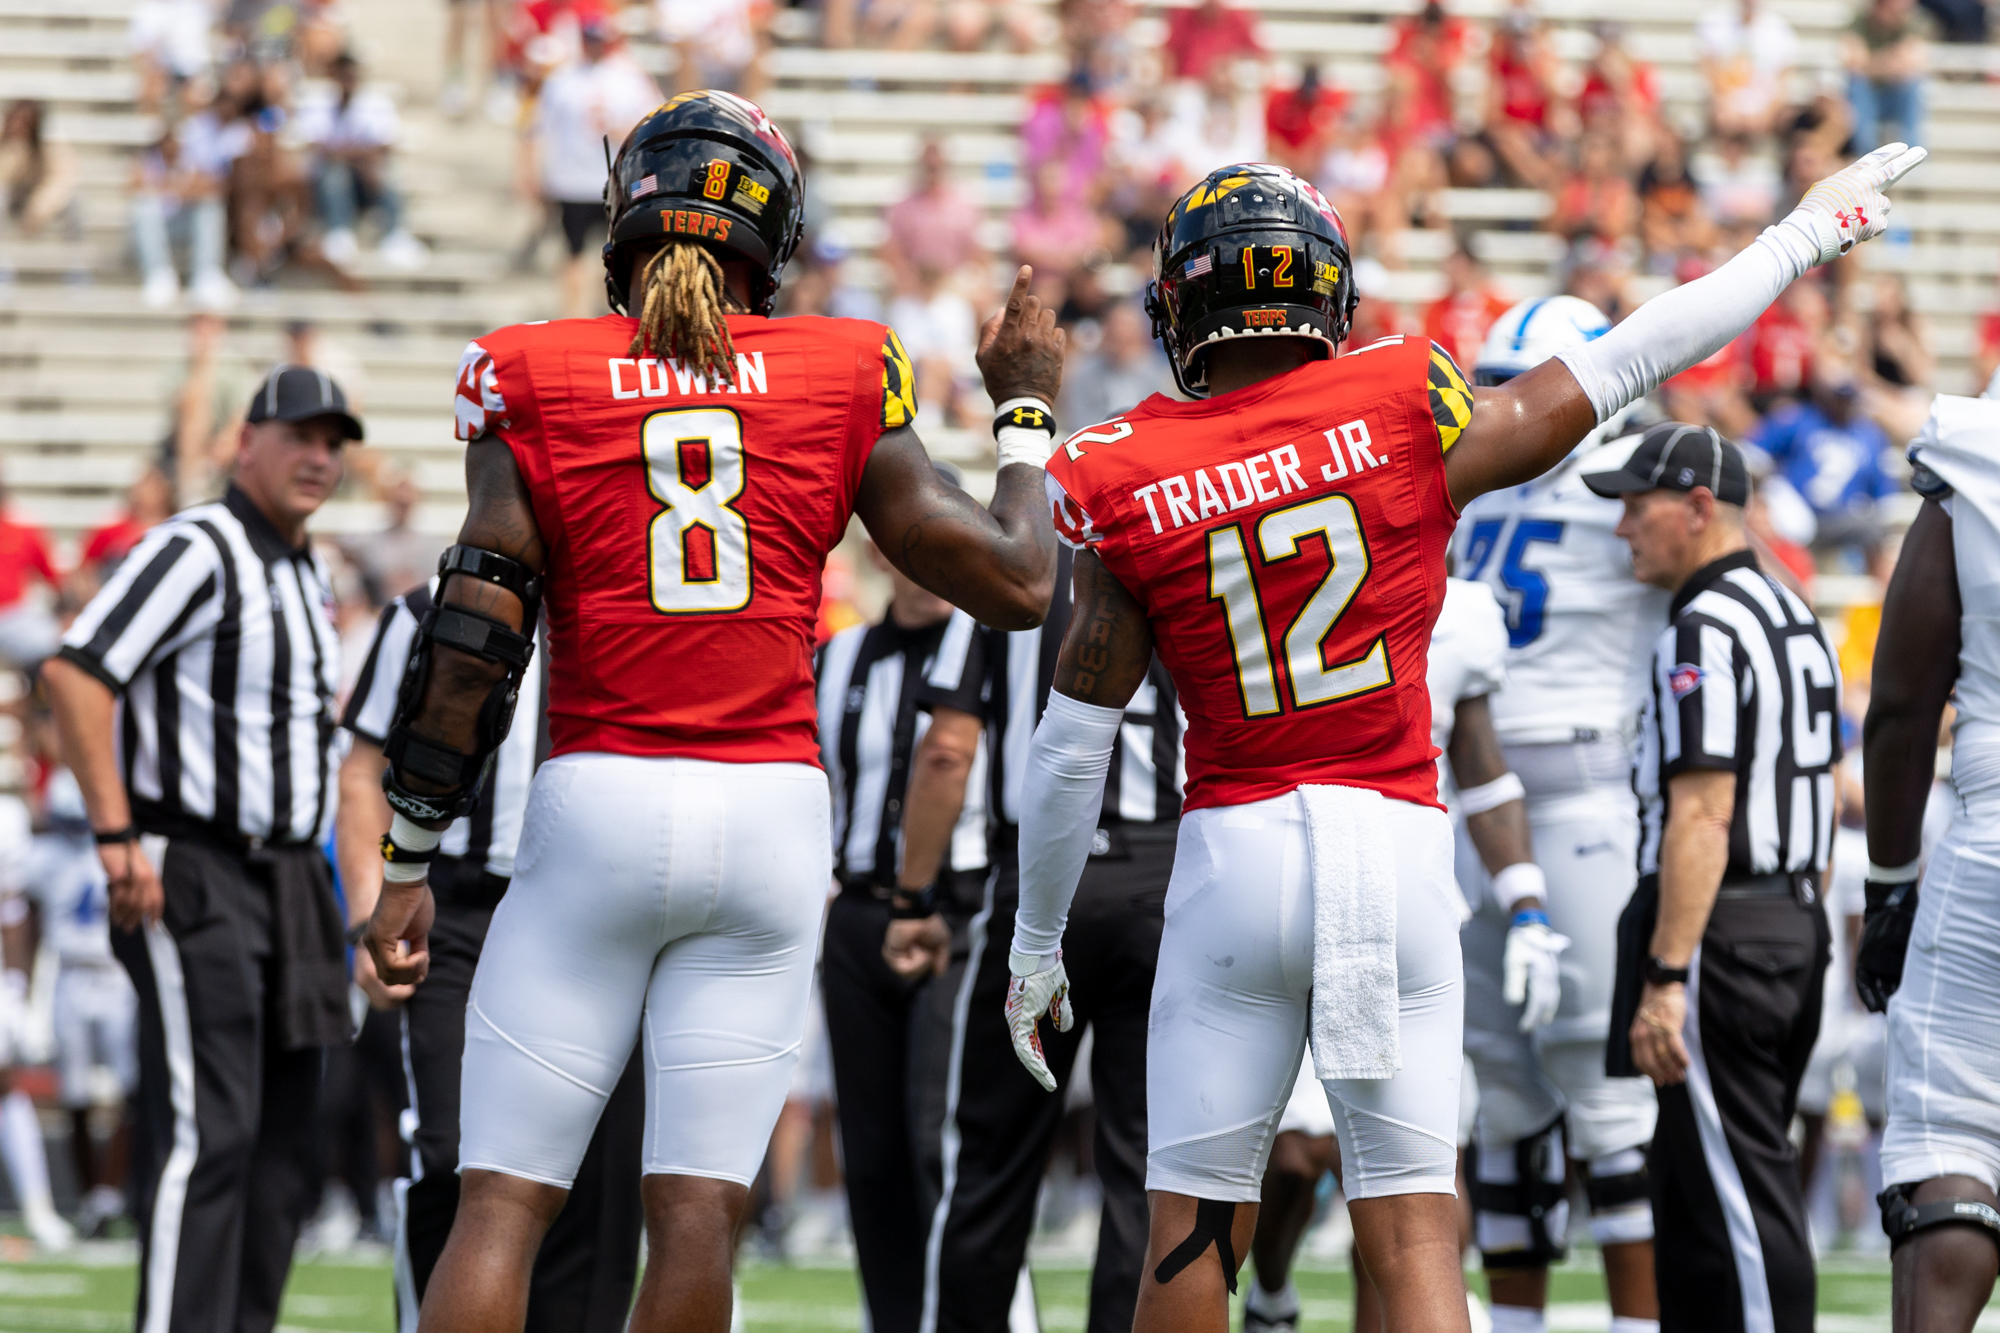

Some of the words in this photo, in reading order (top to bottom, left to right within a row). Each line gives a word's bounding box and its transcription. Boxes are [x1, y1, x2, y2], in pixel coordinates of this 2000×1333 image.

[660, 209, 733, 242] TERPS
[703, 158, 731, 201] 8
[1242, 245, 1294, 290] 12
[1242, 309, 1288, 327] TERPS
[640, 404, 754, 617] 8
[1133, 443, 1309, 536] TRADER
[1320, 418, 1389, 482] JR.
[1072, 566, 1118, 702] ELAWA
[1205, 491, 1395, 721] 12
[1465, 518, 1568, 649] 75
